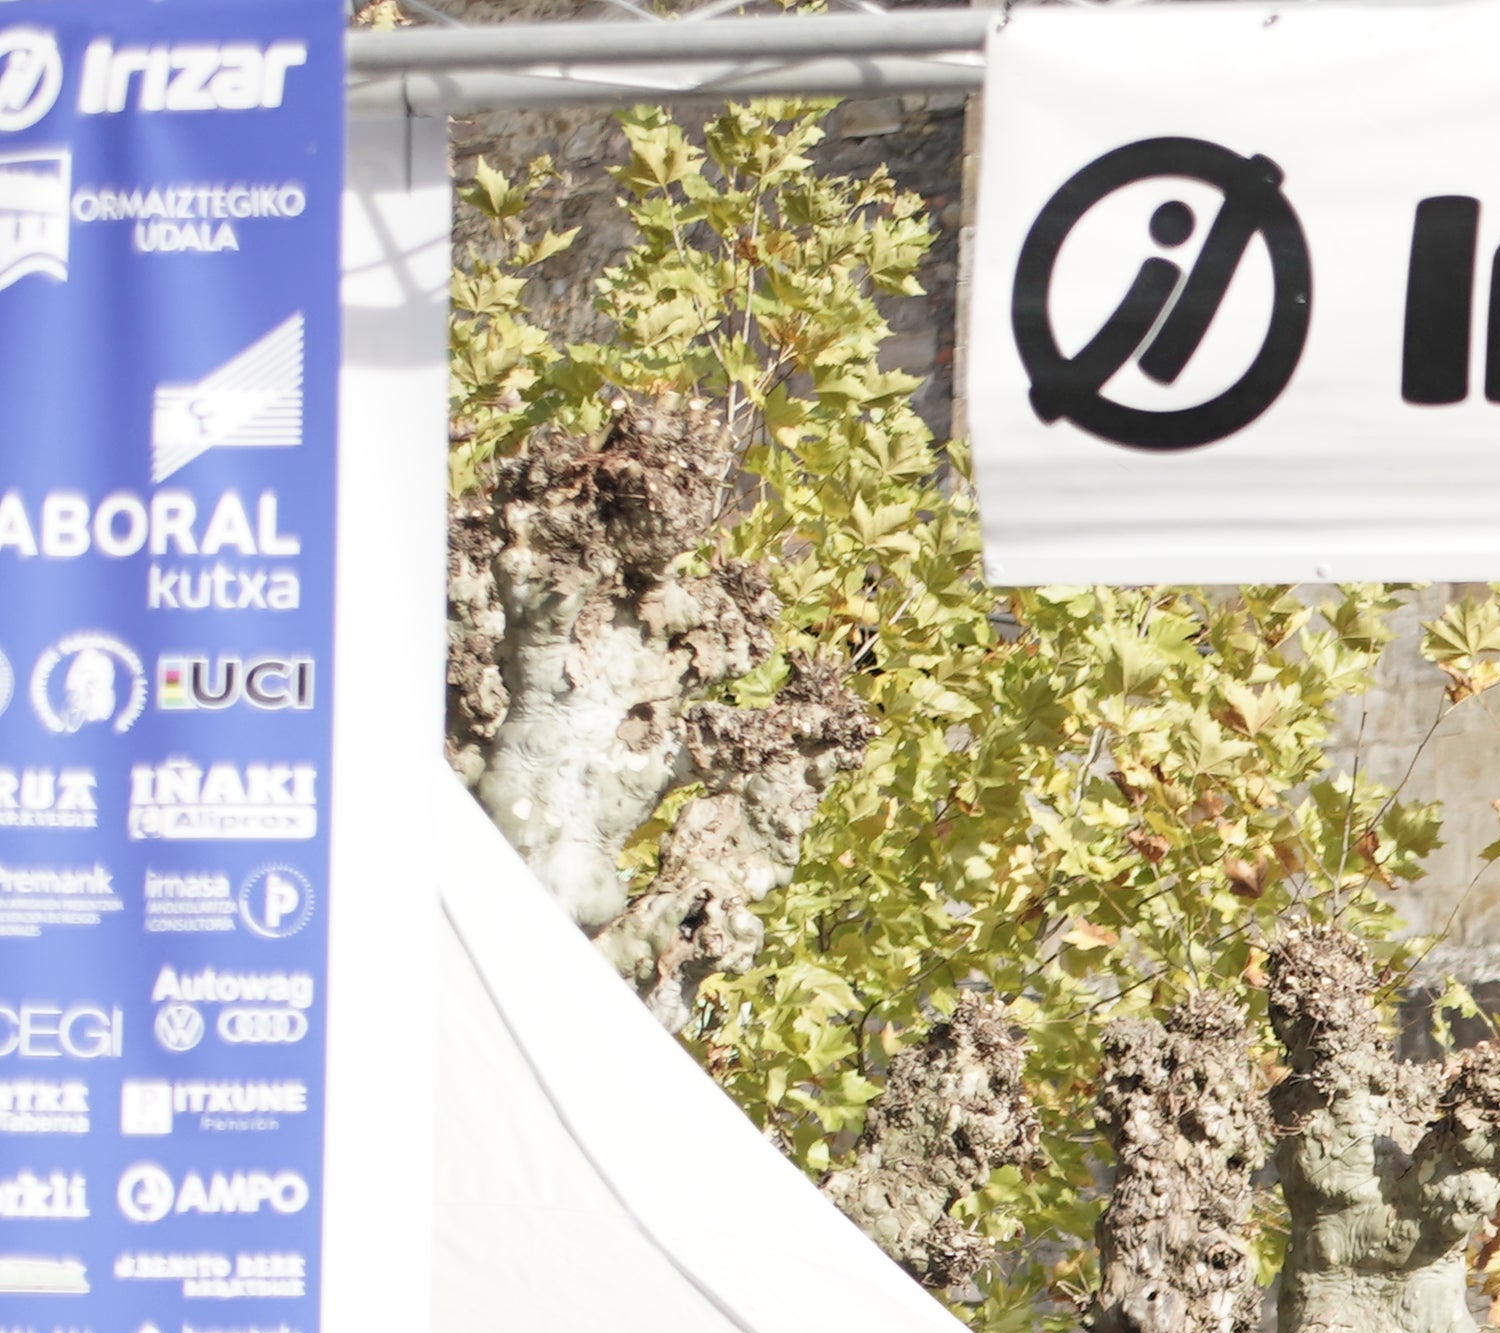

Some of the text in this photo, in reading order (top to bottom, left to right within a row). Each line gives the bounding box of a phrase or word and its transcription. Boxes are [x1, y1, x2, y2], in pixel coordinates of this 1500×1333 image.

[78, 40, 307, 114] Irizar
[72, 187, 305, 222] ORMAIZTEGIKO
[135, 222, 240, 252] UDALA
[148, 566, 300, 610] kutxa
[188, 658, 314, 710] UCI
[130, 755, 318, 806] IÑAKI
[152, 966, 314, 1009] Autowag
[175, 1172, 310, 1214] AMPO
